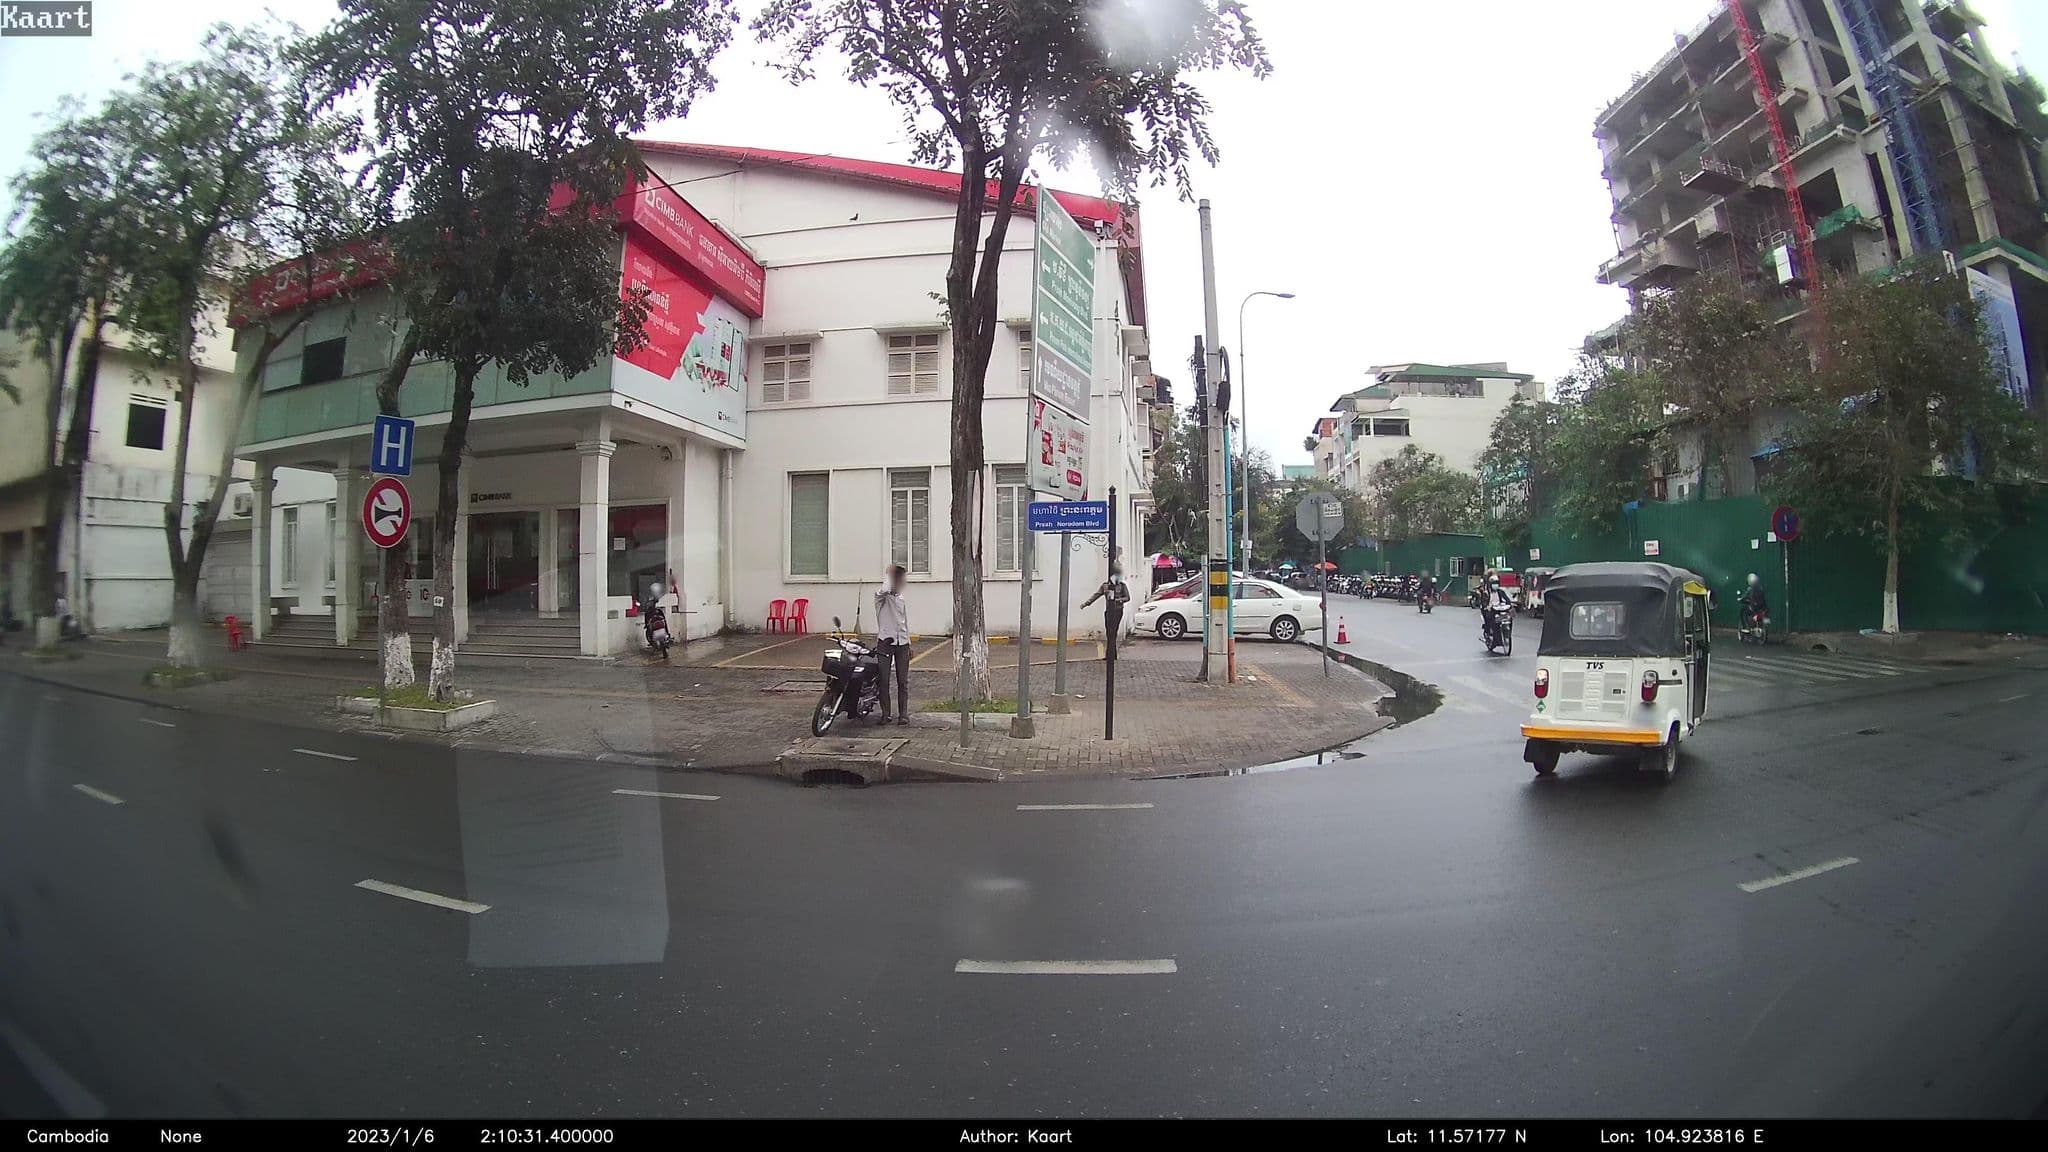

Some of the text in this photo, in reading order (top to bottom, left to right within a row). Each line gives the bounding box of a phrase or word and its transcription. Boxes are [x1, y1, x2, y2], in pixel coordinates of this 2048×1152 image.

[656, 197, 675, 222] CIMB
[675, 212, 694, 238] BANK
[380, 424, 406, 467] H
[1586, 661, 1605, 670] TVS
